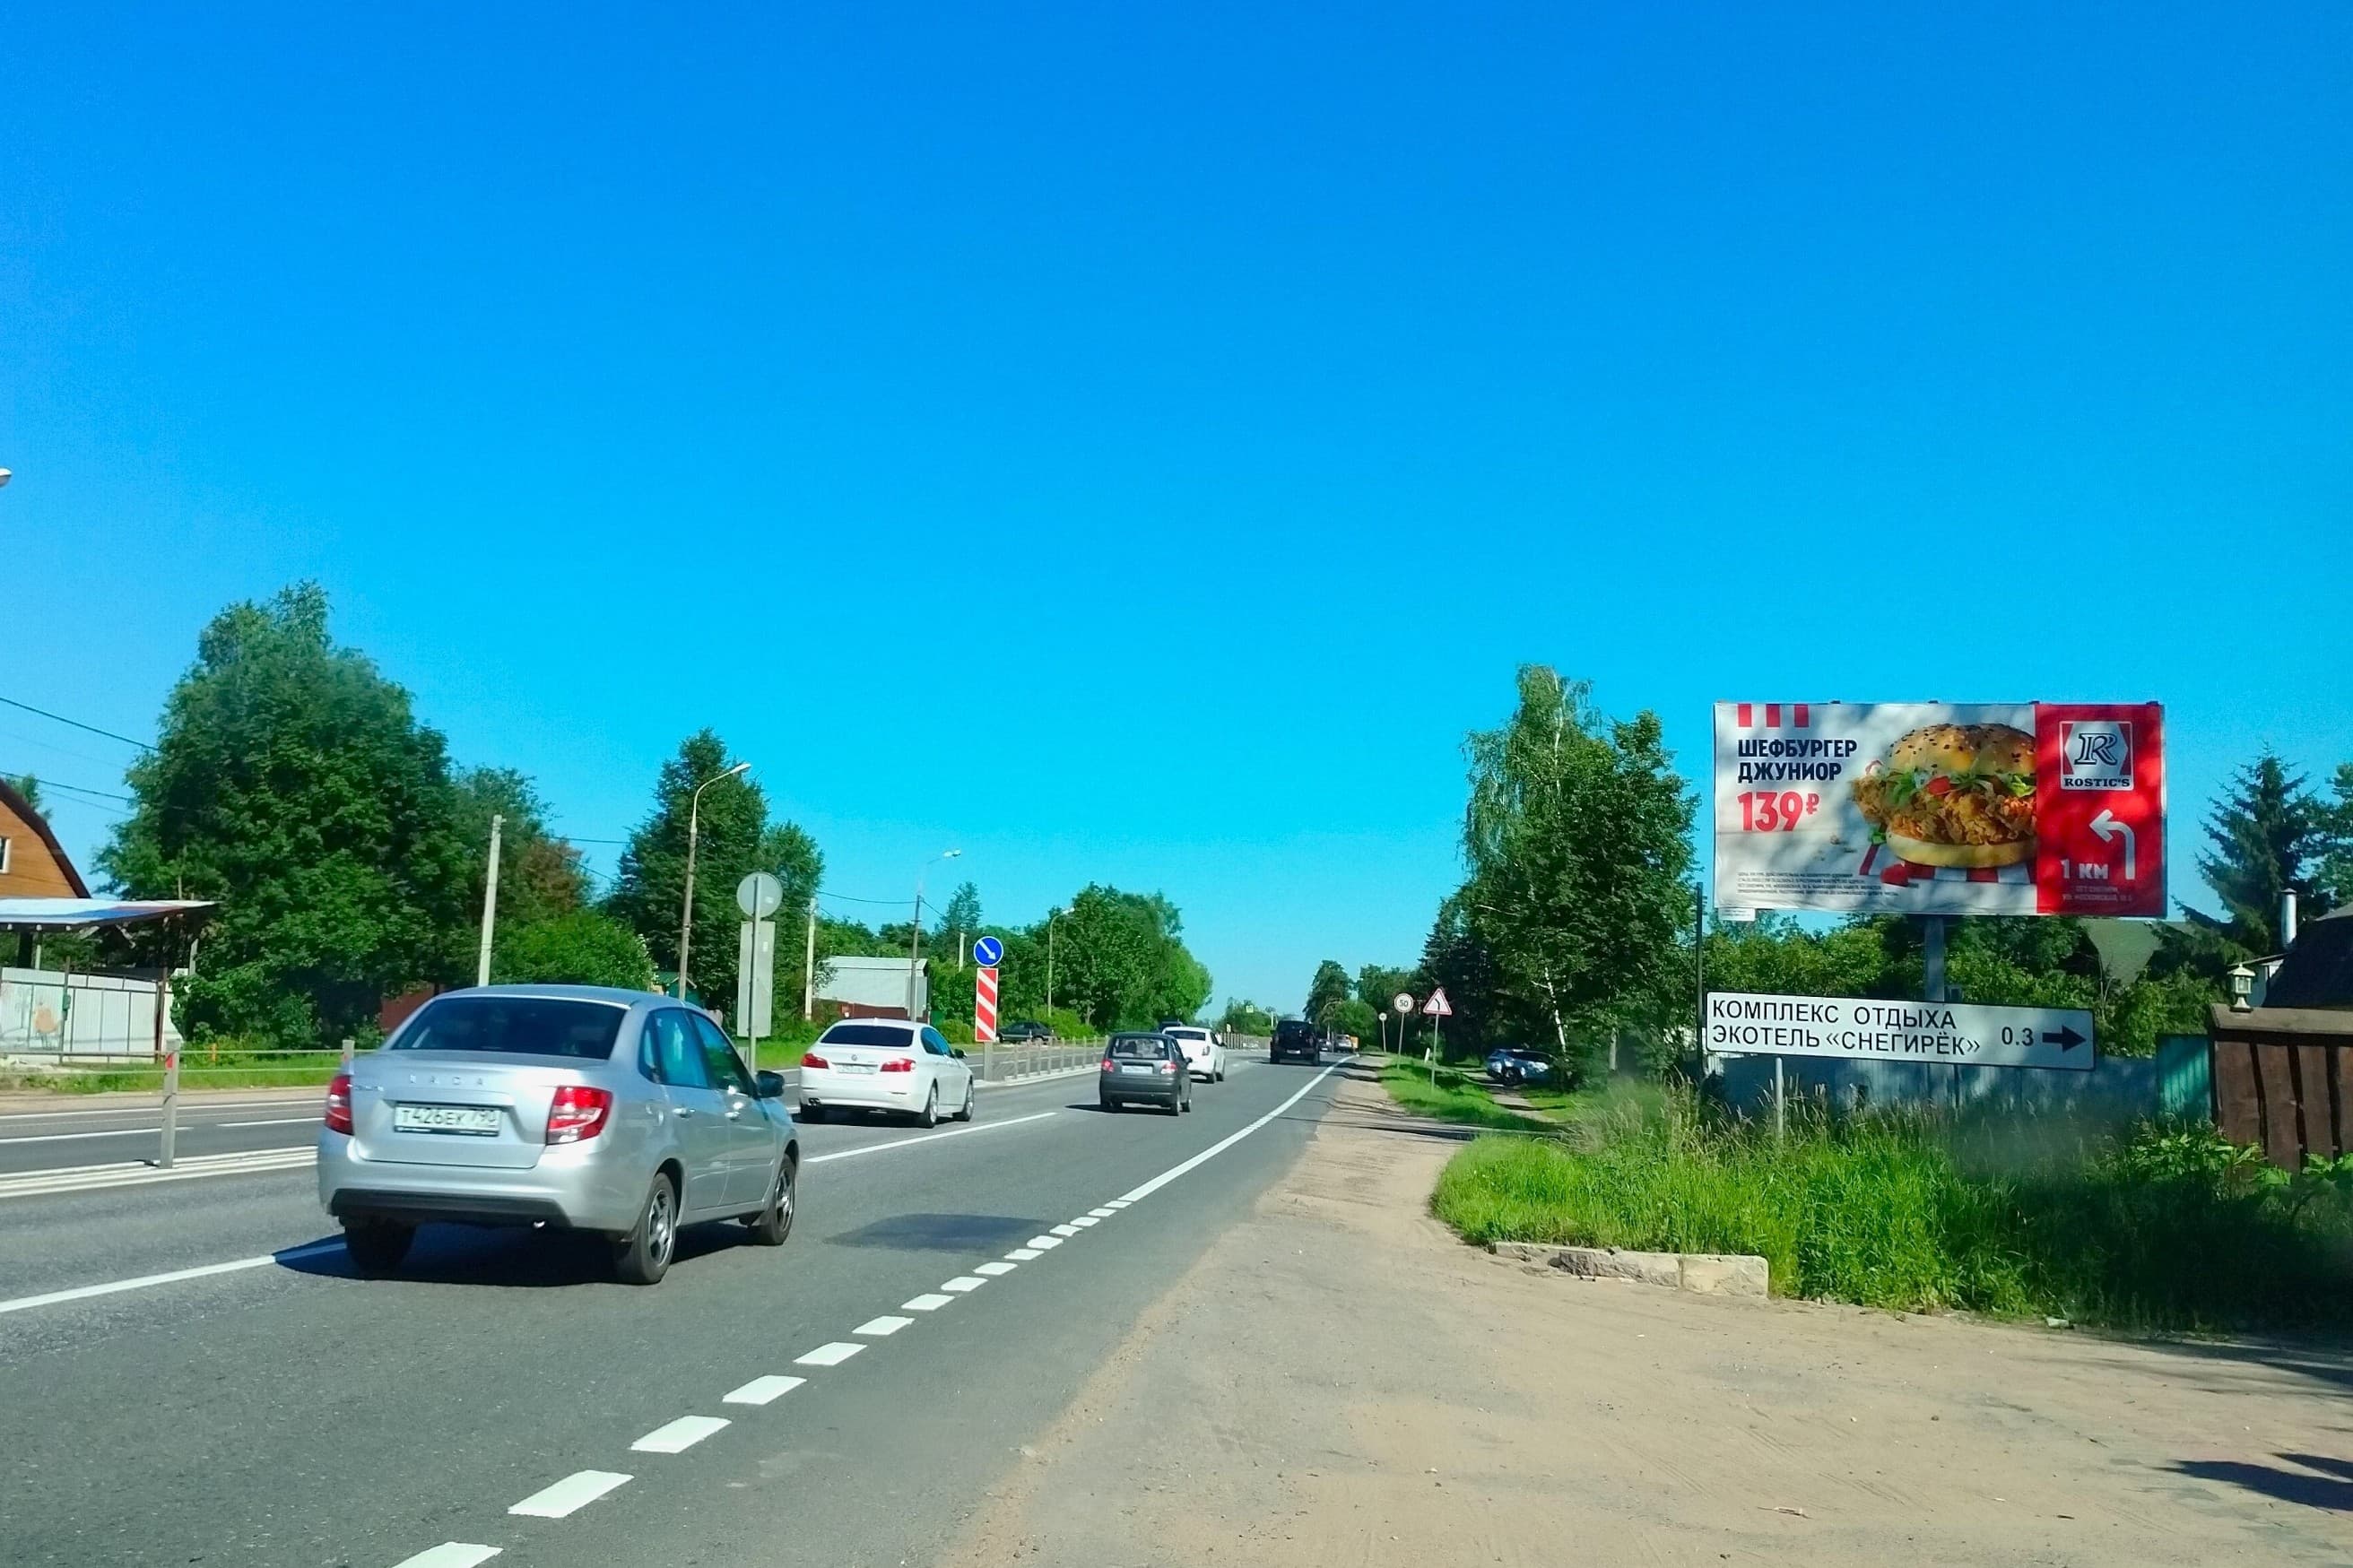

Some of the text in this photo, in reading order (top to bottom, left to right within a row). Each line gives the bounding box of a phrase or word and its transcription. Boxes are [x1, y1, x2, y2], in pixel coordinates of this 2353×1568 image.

[1738, 739, 1857, 758] ШЕФБУРГЕР
[1738, 762, 1842, 784] ДЖУНИОР
[2063, 777, 2131, 787] ROSTIC'S
[2061, 859, 2071, 879] 1
[1399, 999, 1409, 1008] 50
[1713, 999, 1957, 1030] КОМПЛЕКС ОТДЫХА
[1713, 1025, 1981, 1056] ЭКОТЕЛЬ «СНЕГИРЁК»
[2001, 1027, 2034, 1046] 0.3
